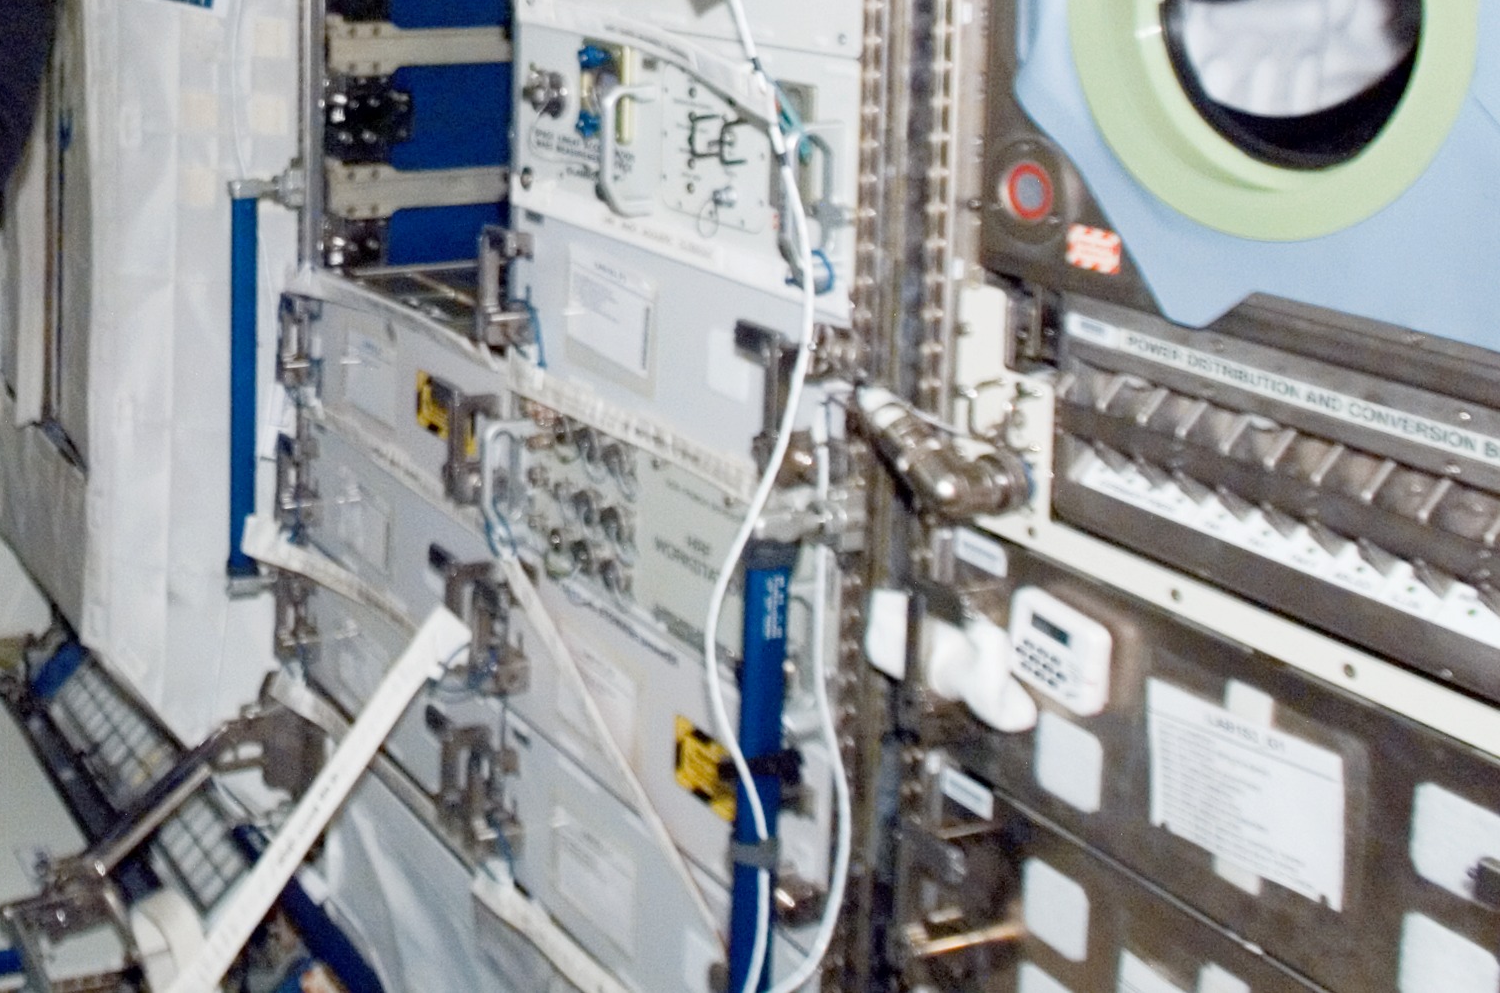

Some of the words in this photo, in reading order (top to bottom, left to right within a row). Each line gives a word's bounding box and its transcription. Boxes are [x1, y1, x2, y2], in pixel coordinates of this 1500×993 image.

[1128, 335, 1179, 360] POWER
[1186, 355, 1300, 399] DISTRIBUTION
[1305, 390, 1342, 412] AND
[1349, 402, 1477, 452] CONVERSION
